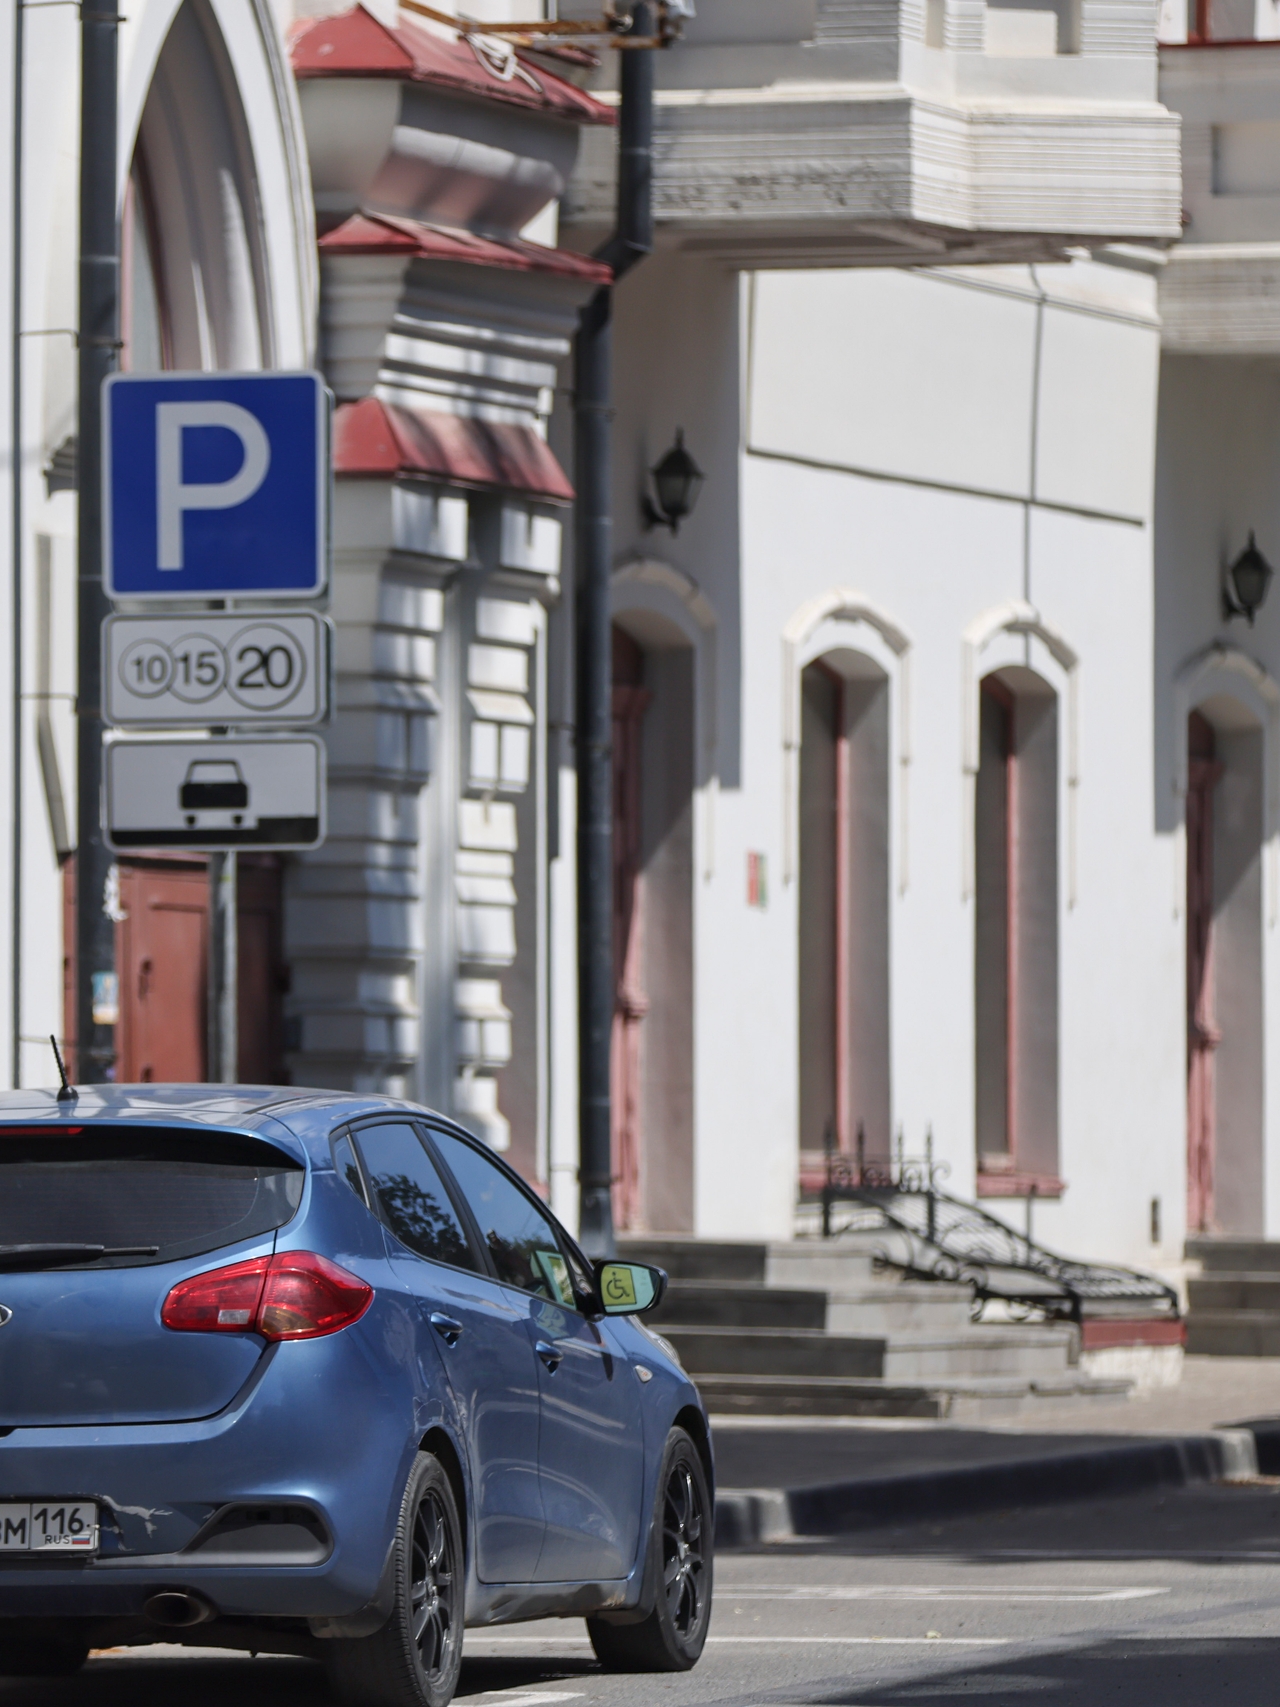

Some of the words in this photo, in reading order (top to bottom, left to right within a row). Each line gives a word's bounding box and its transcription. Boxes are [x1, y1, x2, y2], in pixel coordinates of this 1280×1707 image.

[156, 400, 271, 571] P
[131, 656, 166, 684] 10
[177, 651, 217, 686] 15
[237, 646, 293, 688] 20
[34, 1507, 84, 1535] 116
[45, 1534, 70, 1545] RUS
